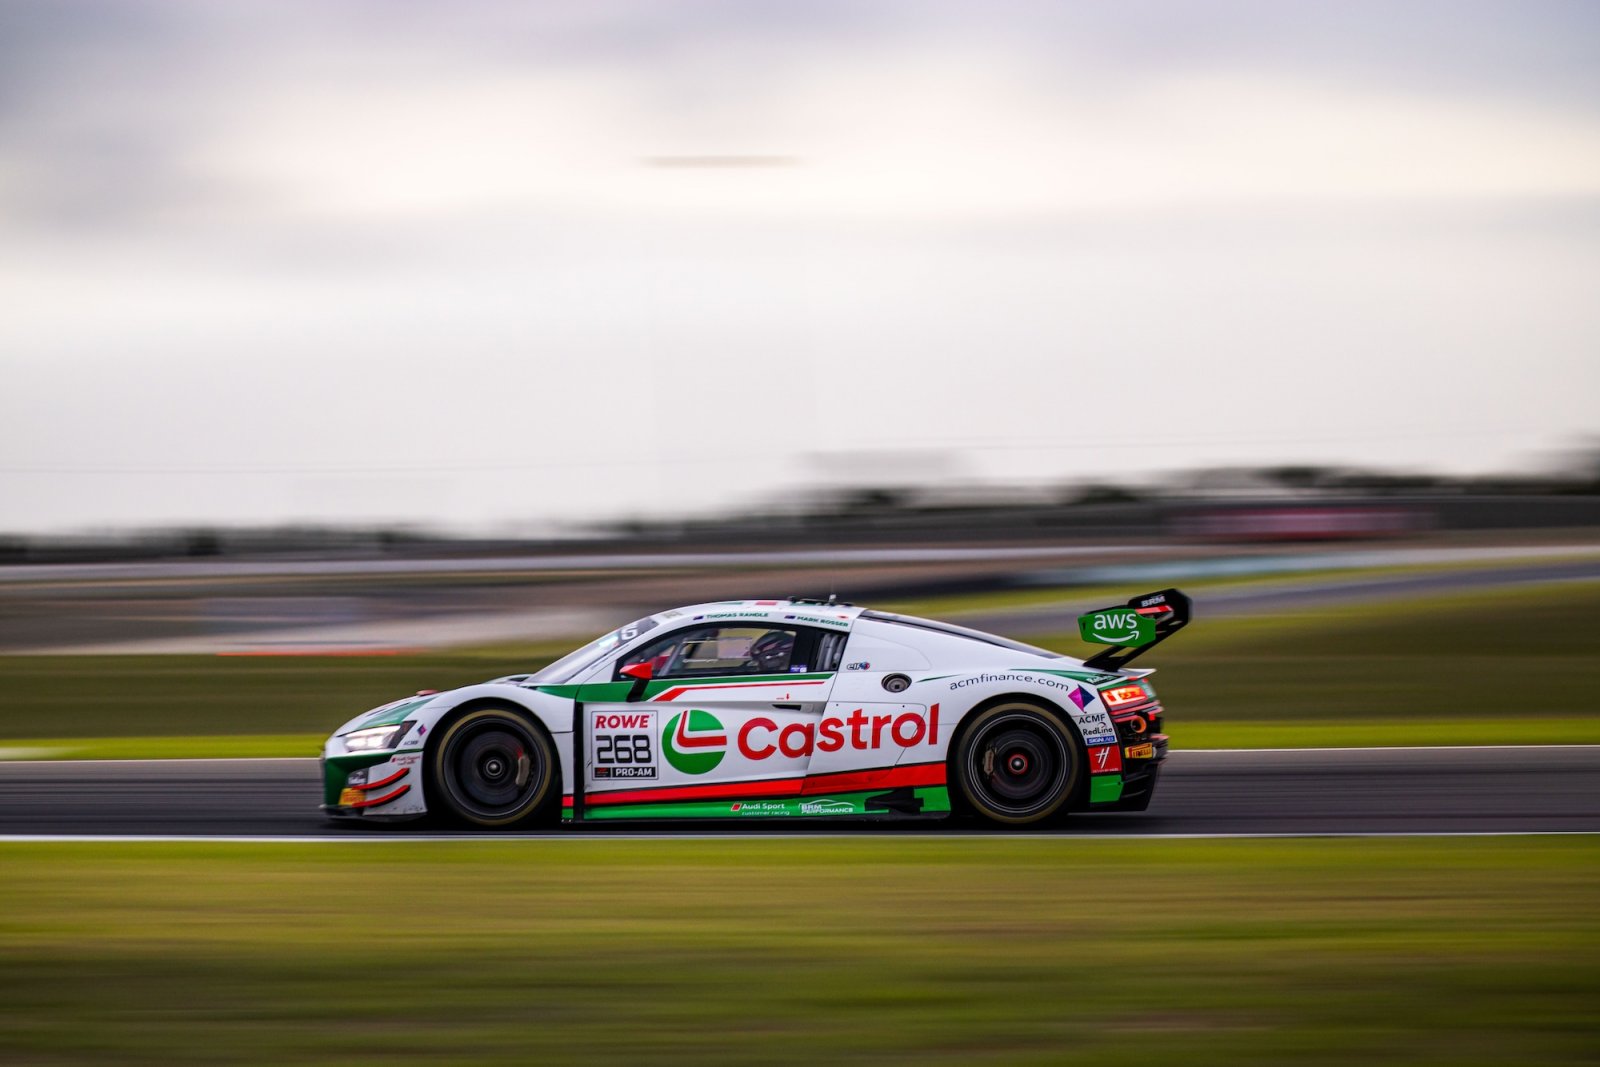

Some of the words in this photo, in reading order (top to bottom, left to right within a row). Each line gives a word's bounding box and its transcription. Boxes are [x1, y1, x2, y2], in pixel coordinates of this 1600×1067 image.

[1093, 613, 1138, 630] aws
[949, 673, 1069, 692] acmfinance.com
[595, 715, 650, 729] ROWE
[1079, 714, 1106, 724] ACMF
[737, 703, 940, 760] Castrol
[1083, 727, 1113, 736] RedLine
[595, 735, 652, 763] 268
[615, 768, 652, 776] PRO-AM
[762, 803, 785, 811] Sport
